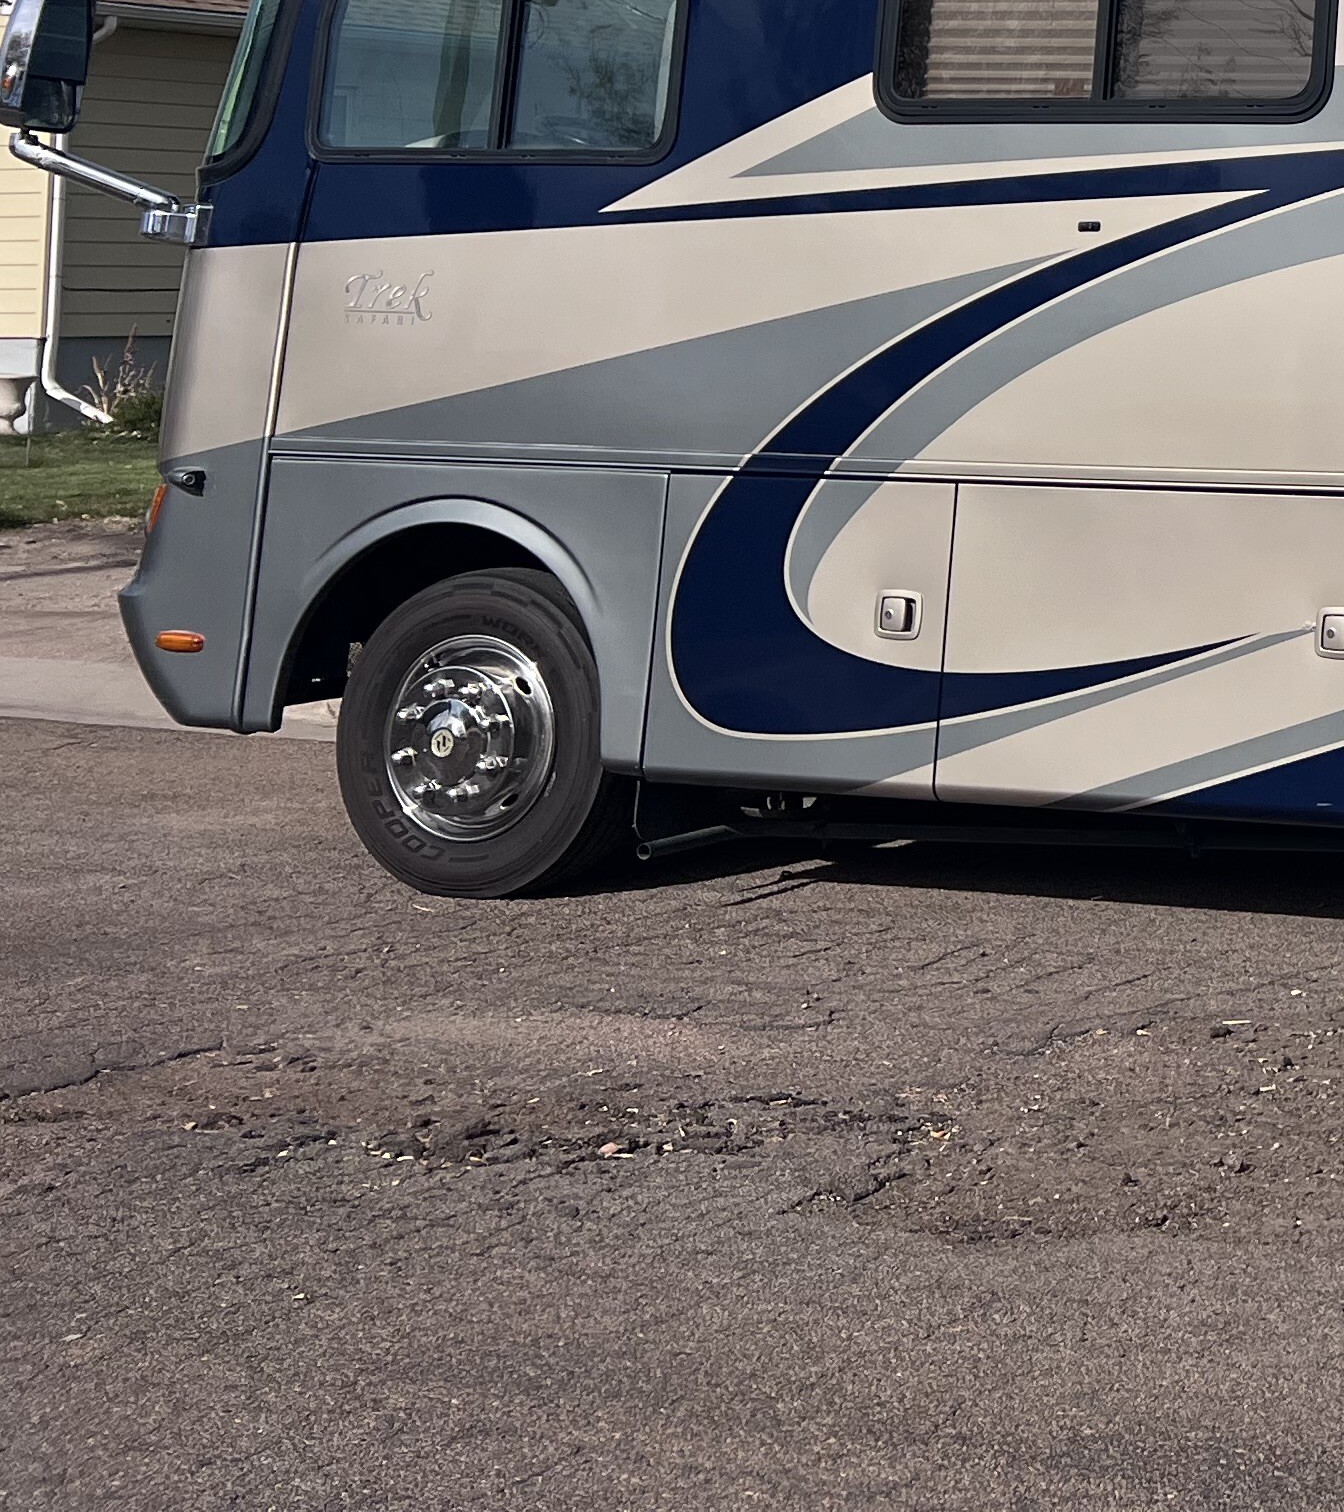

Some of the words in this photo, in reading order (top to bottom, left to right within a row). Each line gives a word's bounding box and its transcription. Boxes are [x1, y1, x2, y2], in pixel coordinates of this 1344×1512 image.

[344, 269, 435, 322] Trek
[344, 314, 415, 326] SAFARI
[364, 751, 446, 860] COOPER
